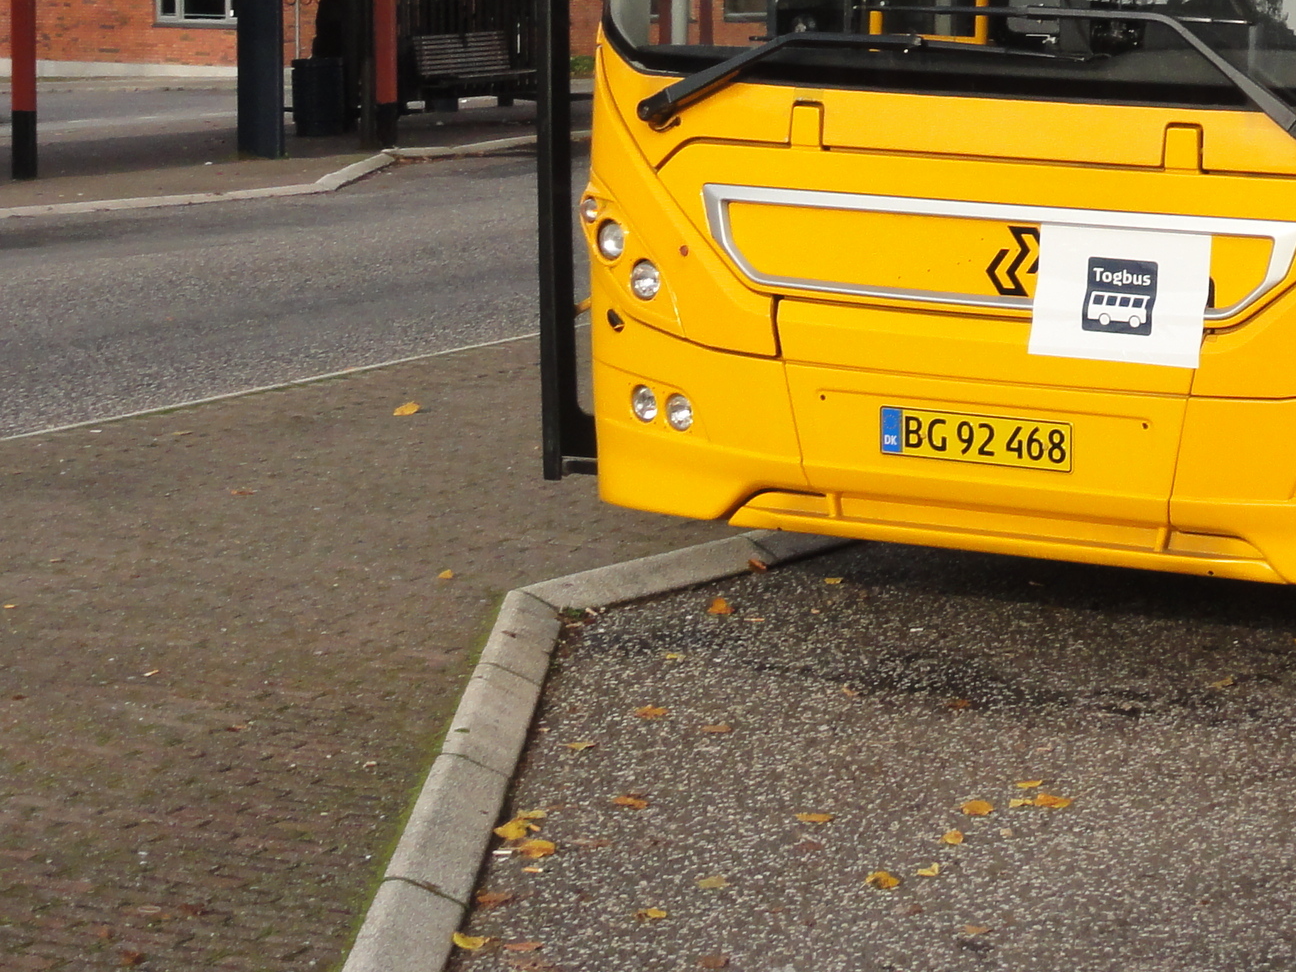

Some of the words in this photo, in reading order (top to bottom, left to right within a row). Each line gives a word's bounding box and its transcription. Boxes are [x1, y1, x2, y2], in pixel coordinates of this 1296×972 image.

[1092, 267, 1152, 287] Togbus
[884, 434, 898, 446] DK
[904, 415, 948, 452] BG
[956, 420, 996, 457] 92
[1005, 425, 1067, 465] 468
